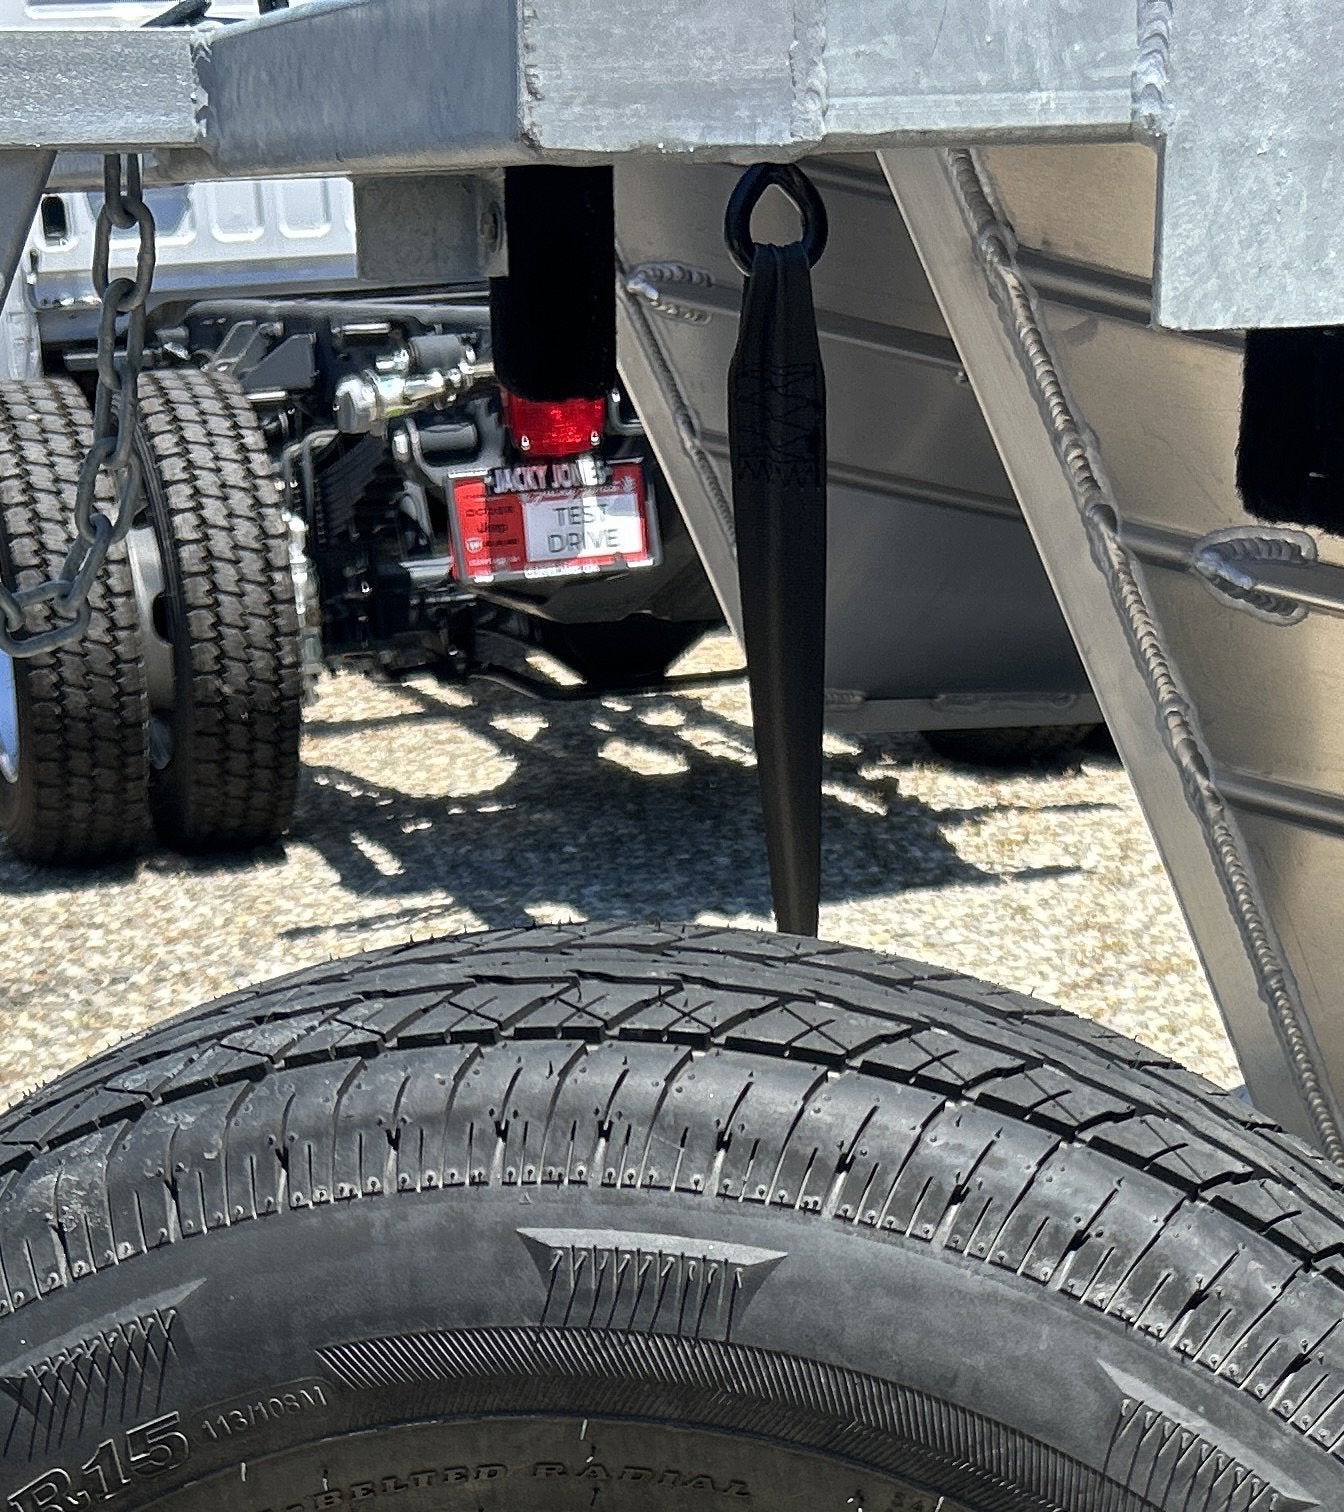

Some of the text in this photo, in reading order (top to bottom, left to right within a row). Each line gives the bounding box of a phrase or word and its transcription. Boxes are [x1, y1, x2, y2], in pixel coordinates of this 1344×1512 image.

[494, 464, 549, 494] JACKY
[555, 503, 608, 526] TEST
[548, 529, 620, 554] DRIVE
[527, 1460, 755, 1502] RADIAL
